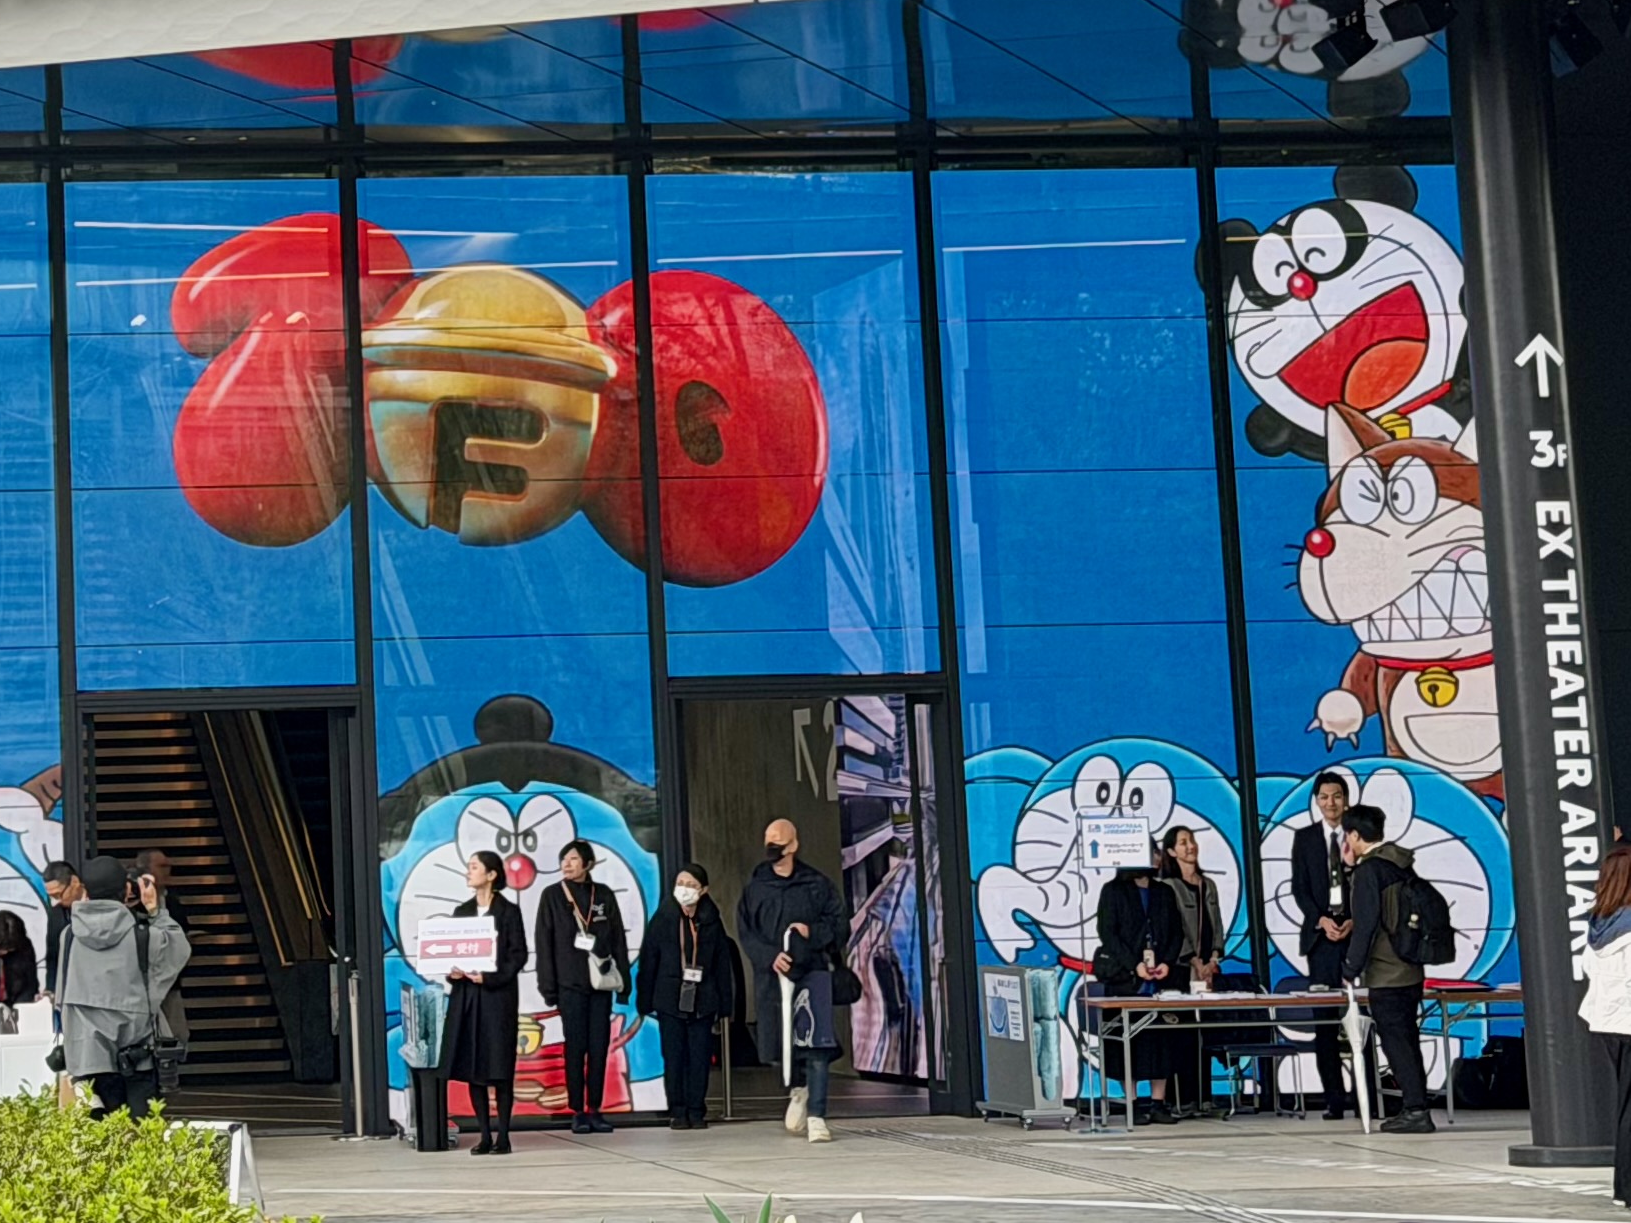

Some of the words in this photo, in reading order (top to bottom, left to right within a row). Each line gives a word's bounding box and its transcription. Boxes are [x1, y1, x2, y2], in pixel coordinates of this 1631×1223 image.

[1529, 430, 1567, 468] 3F
[1535, 501, 1575, 559] EX
[1541, 569, 1592, 790] THEATER
[455, 942, 479, 955] 受付
